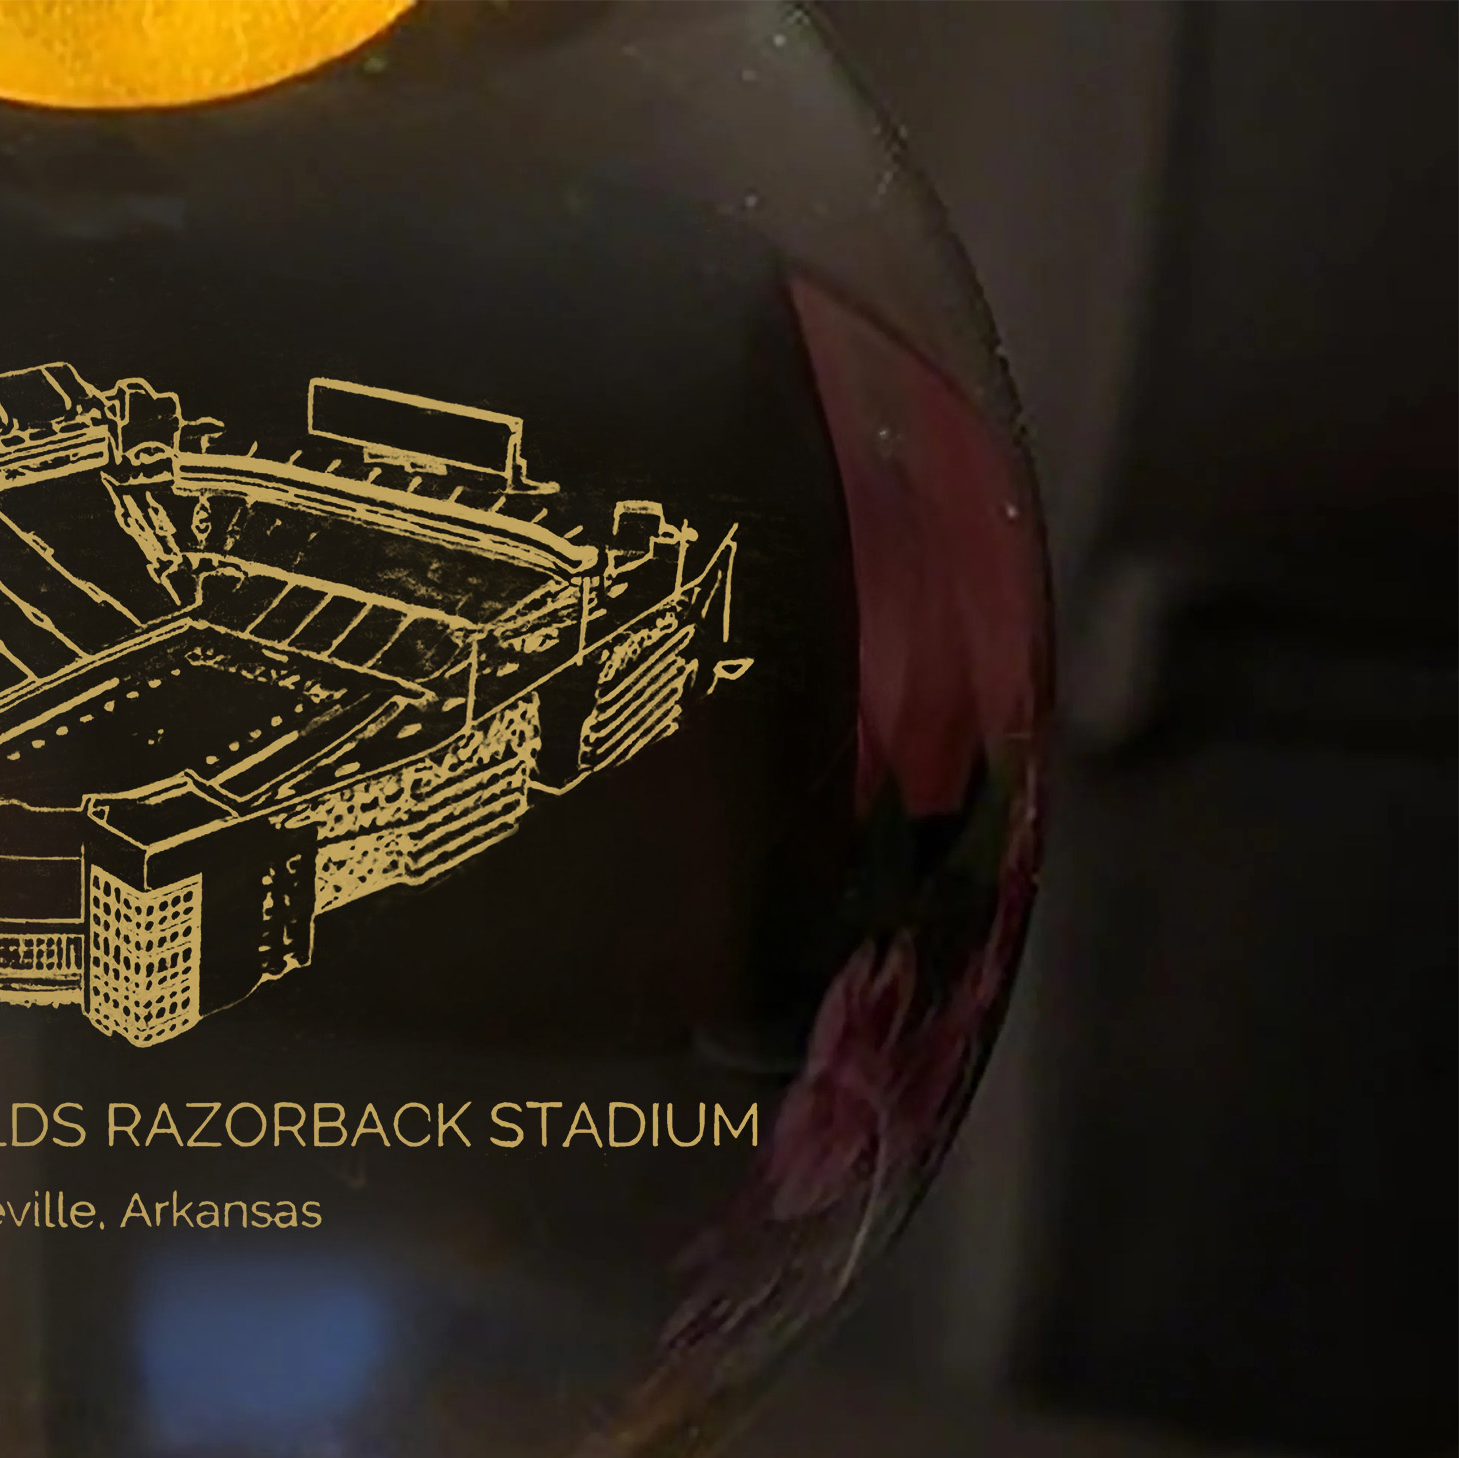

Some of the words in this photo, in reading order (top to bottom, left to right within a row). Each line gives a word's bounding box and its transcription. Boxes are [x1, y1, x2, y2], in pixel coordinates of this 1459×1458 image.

[108, 1101, 472, 1148] RAZORBACK
[489, 1101, 759, 1149] STADIUM
[119, 1190, 322, 1229] Arkansas
